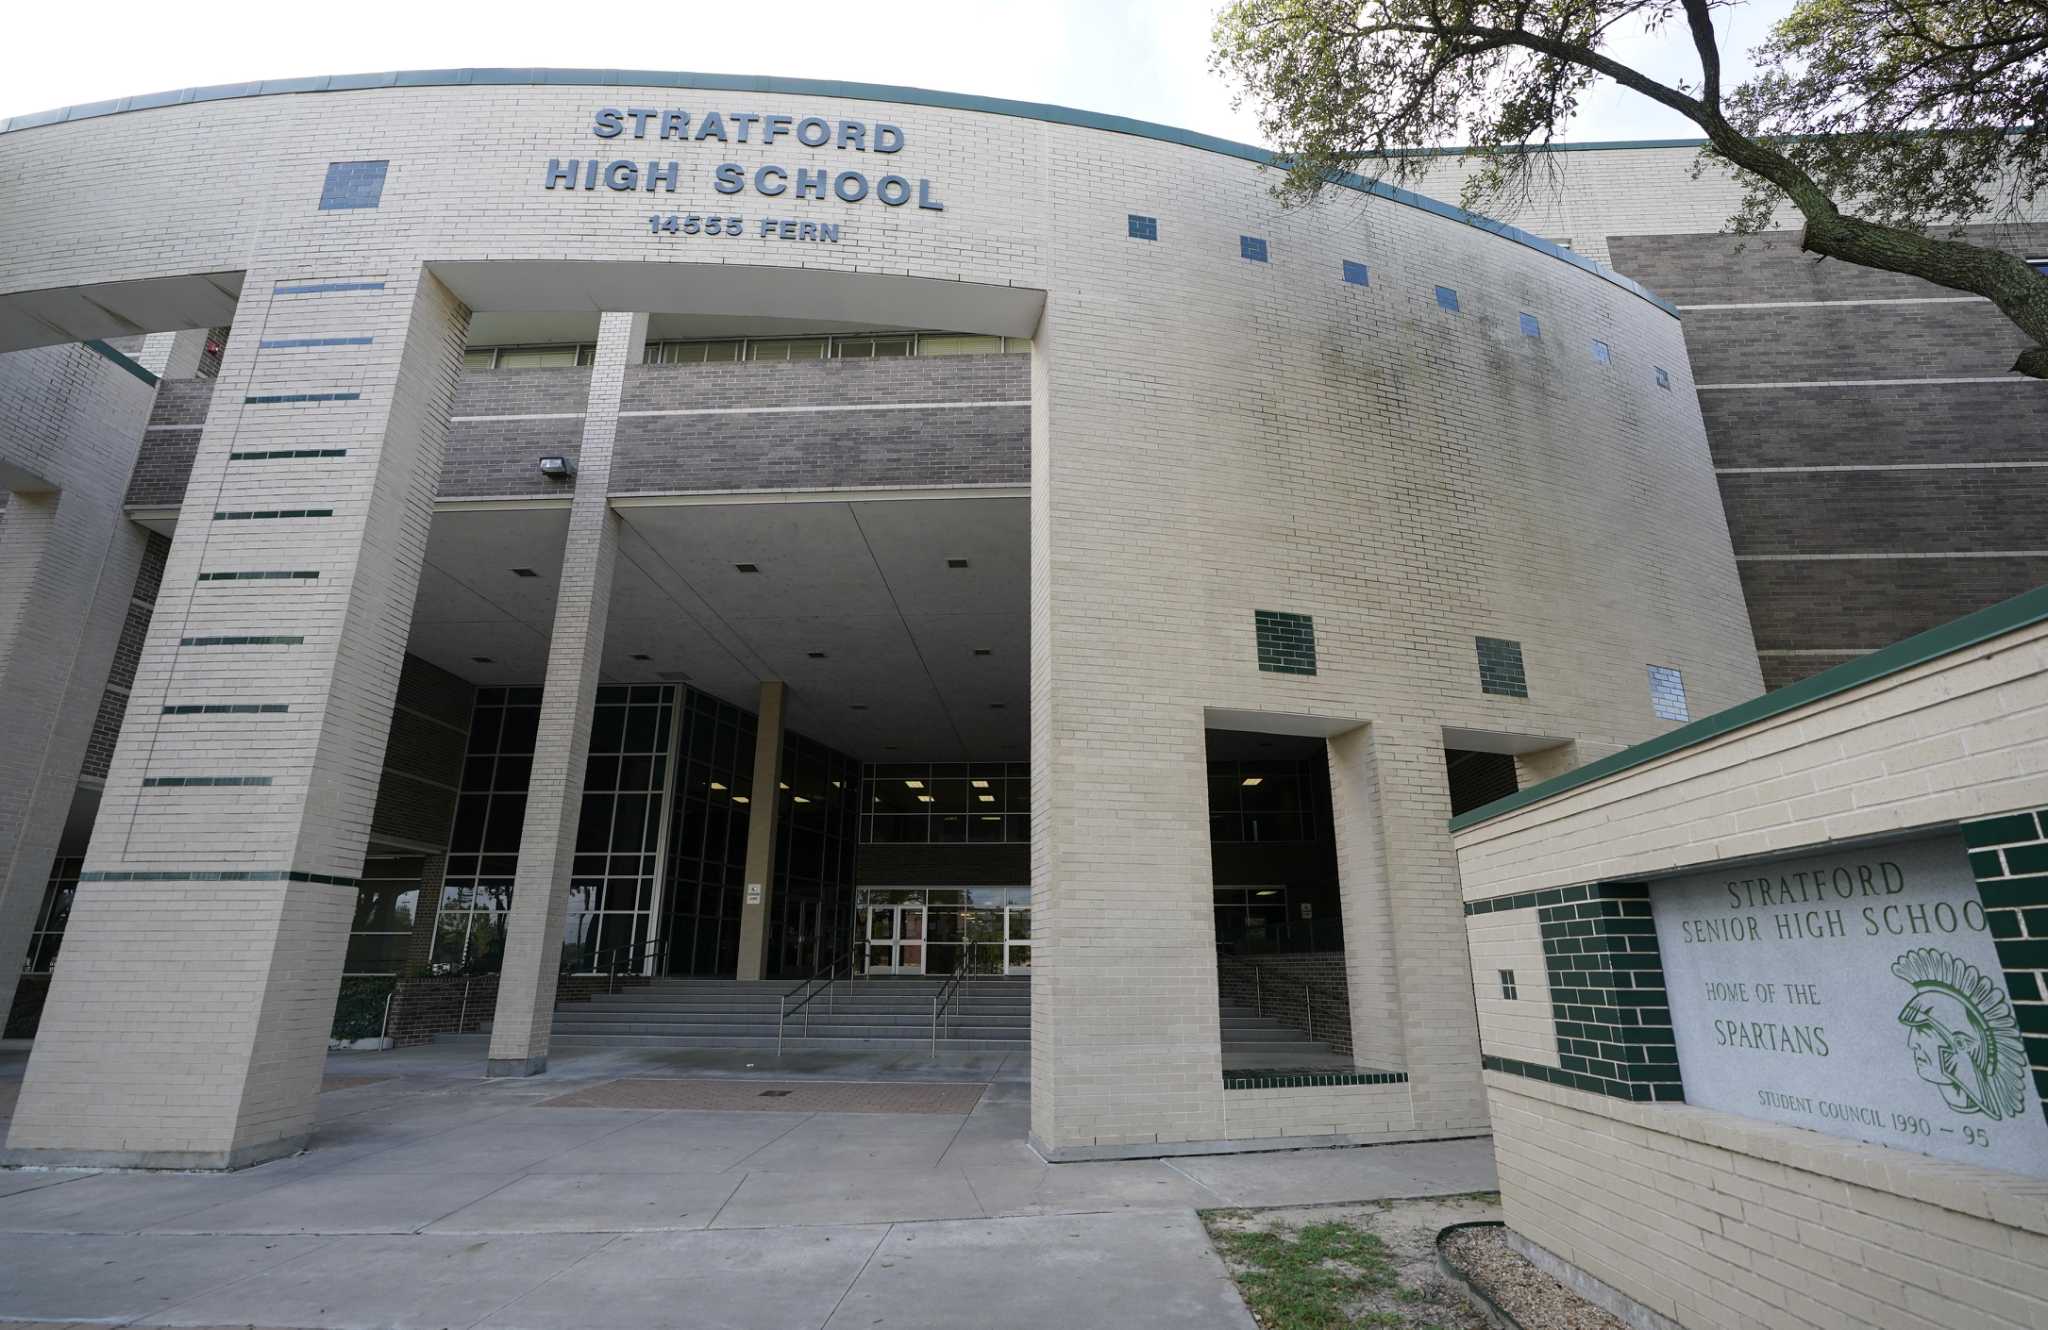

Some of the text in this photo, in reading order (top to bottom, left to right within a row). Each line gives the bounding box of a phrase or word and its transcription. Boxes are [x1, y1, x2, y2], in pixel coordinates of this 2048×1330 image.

[593, 108, 904, 153] STRATFORD
[545, 158, 944, 211] HIGH SCHOOL
[649, 213, 840, 243] 14555 FERN
[1727, 861, 1904, 909] STRATFORD
[1682, 917, 1762, 943] SENIOR
[1776, 909, 1846, 939] HIGH
[1705, 981, 1822, 1006] HOME OF THE
[1714, 1019, 1830, 1057] SPARTANS
[1758, 1089, 1813, 1116] STUDENT
[1819, 1099, 1887, 1130] COUNCIL
[1891, 1112, 1932, 1138] 1990
[1963, 1124, 1991, 1149] 95
